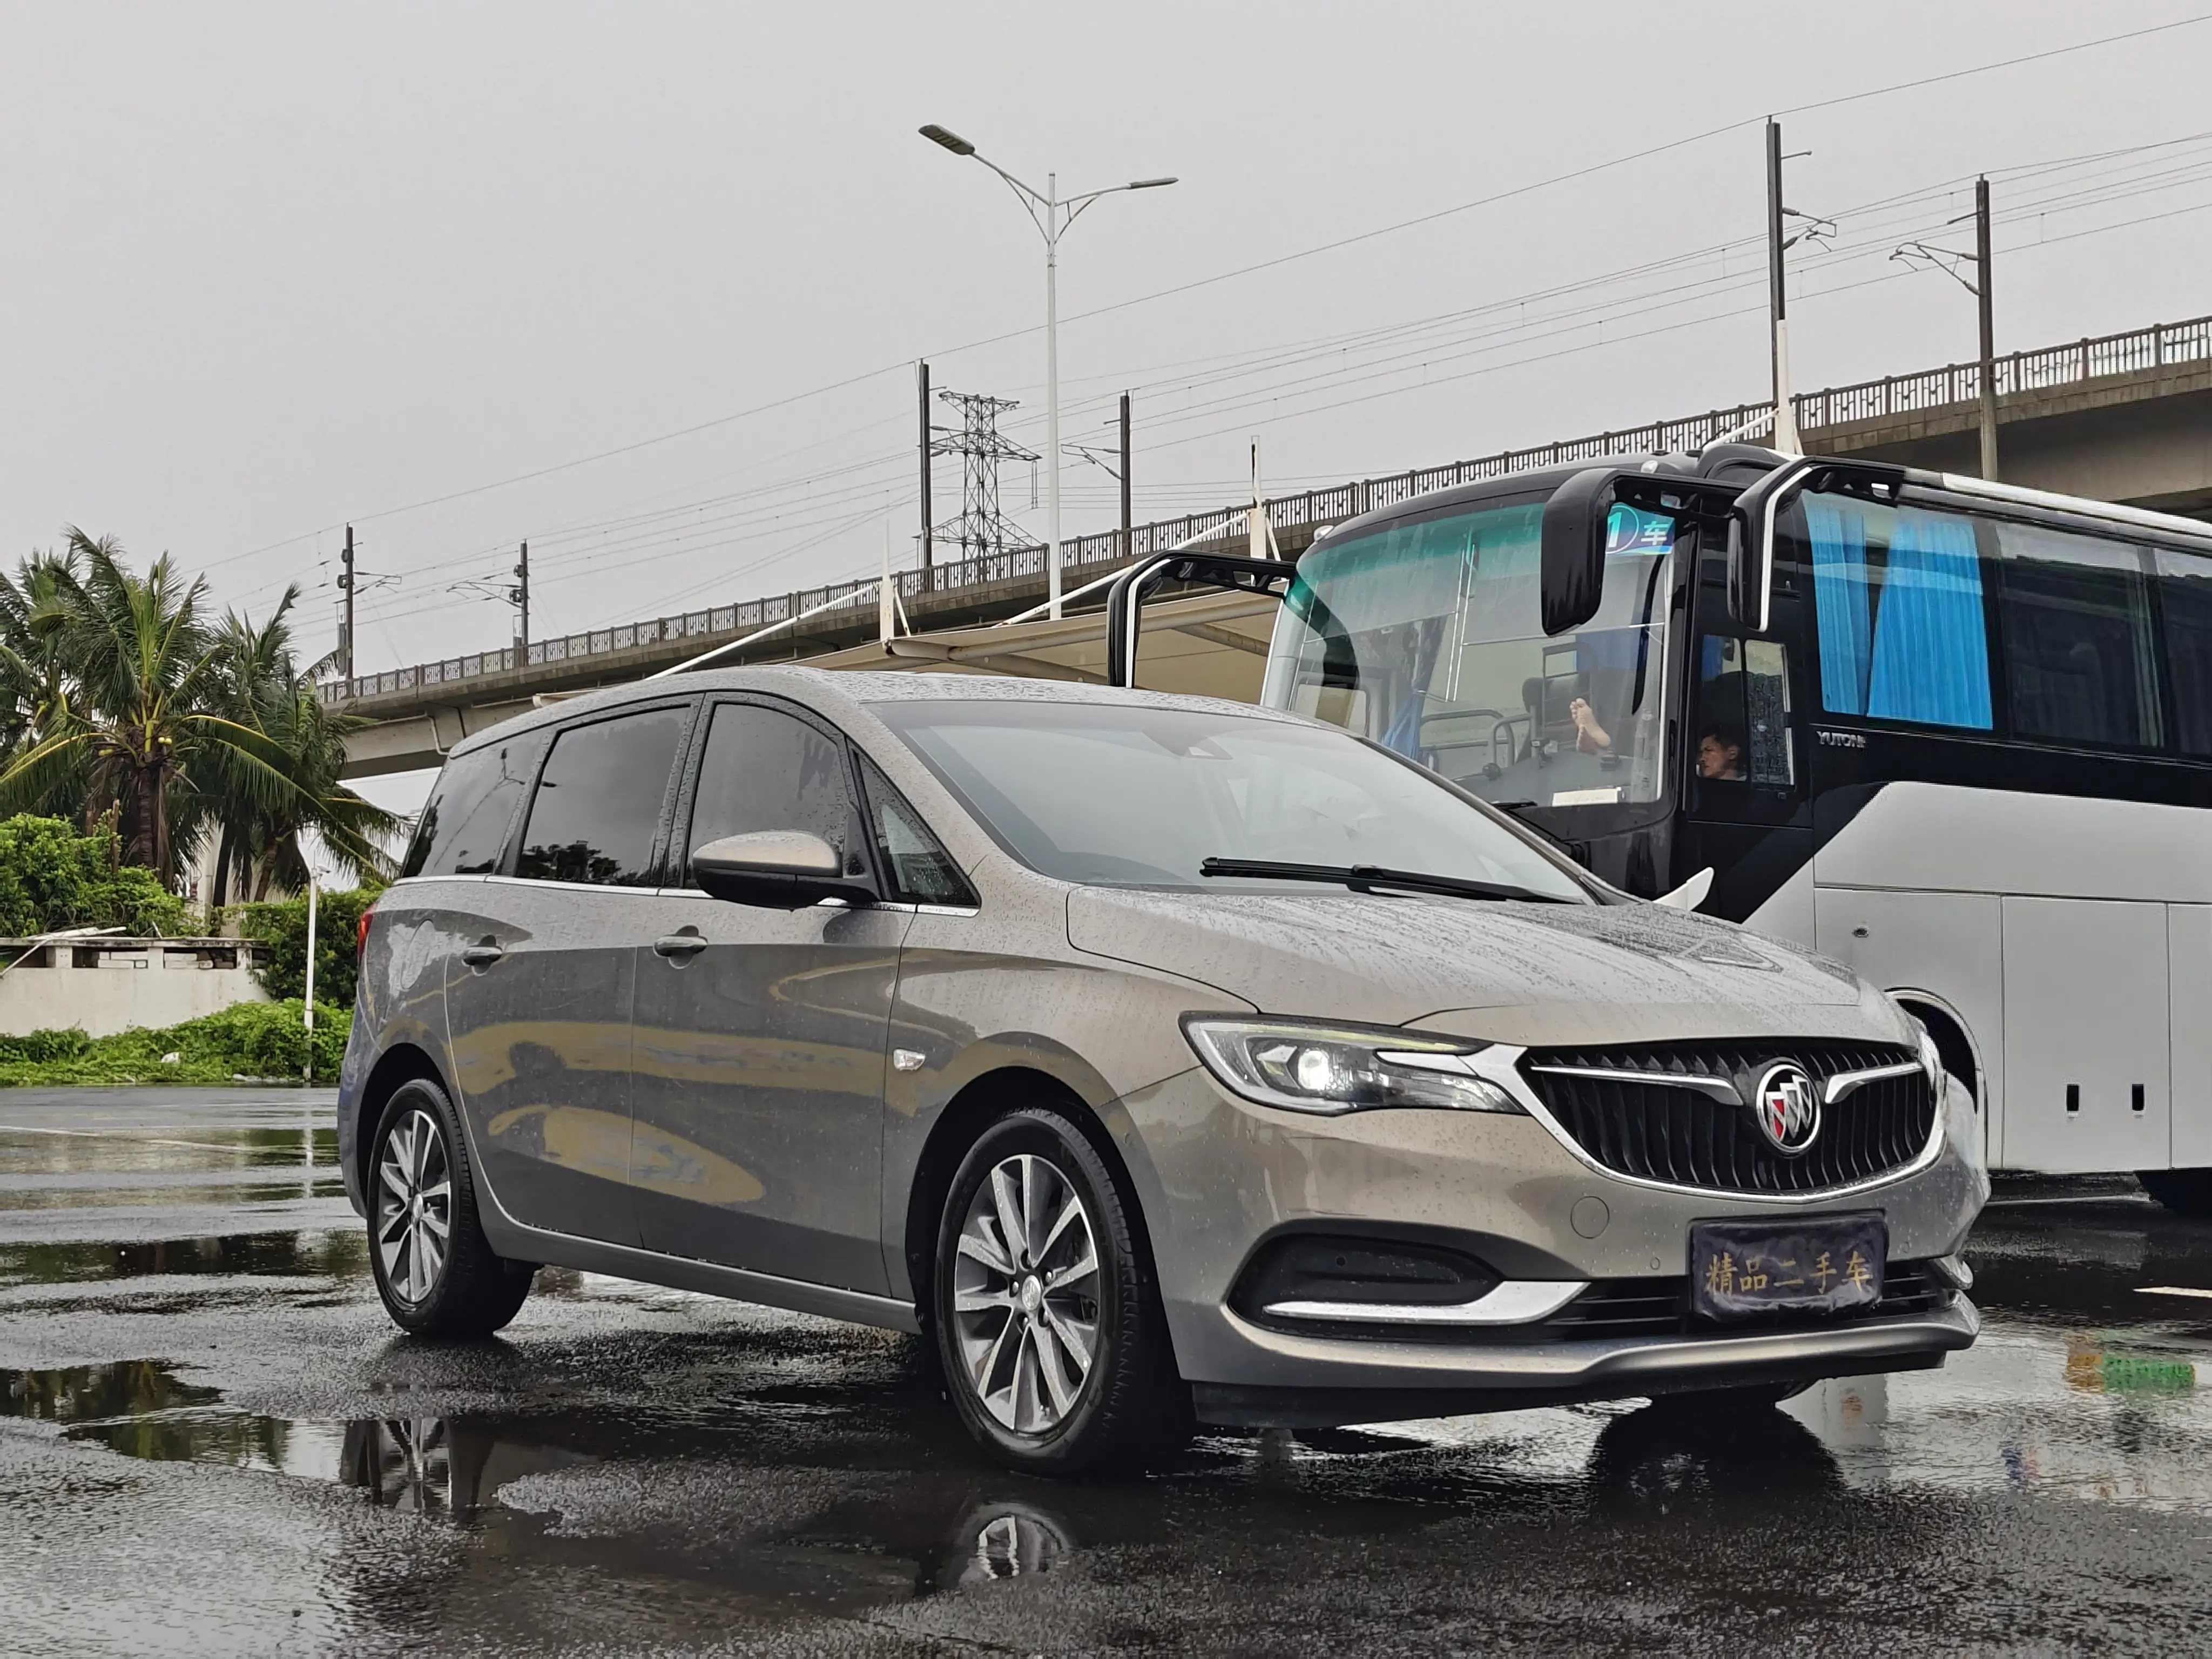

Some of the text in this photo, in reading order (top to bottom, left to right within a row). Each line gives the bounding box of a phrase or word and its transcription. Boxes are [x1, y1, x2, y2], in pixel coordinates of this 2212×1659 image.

[1705, 1250, 1874, 1297] 精品二手车
